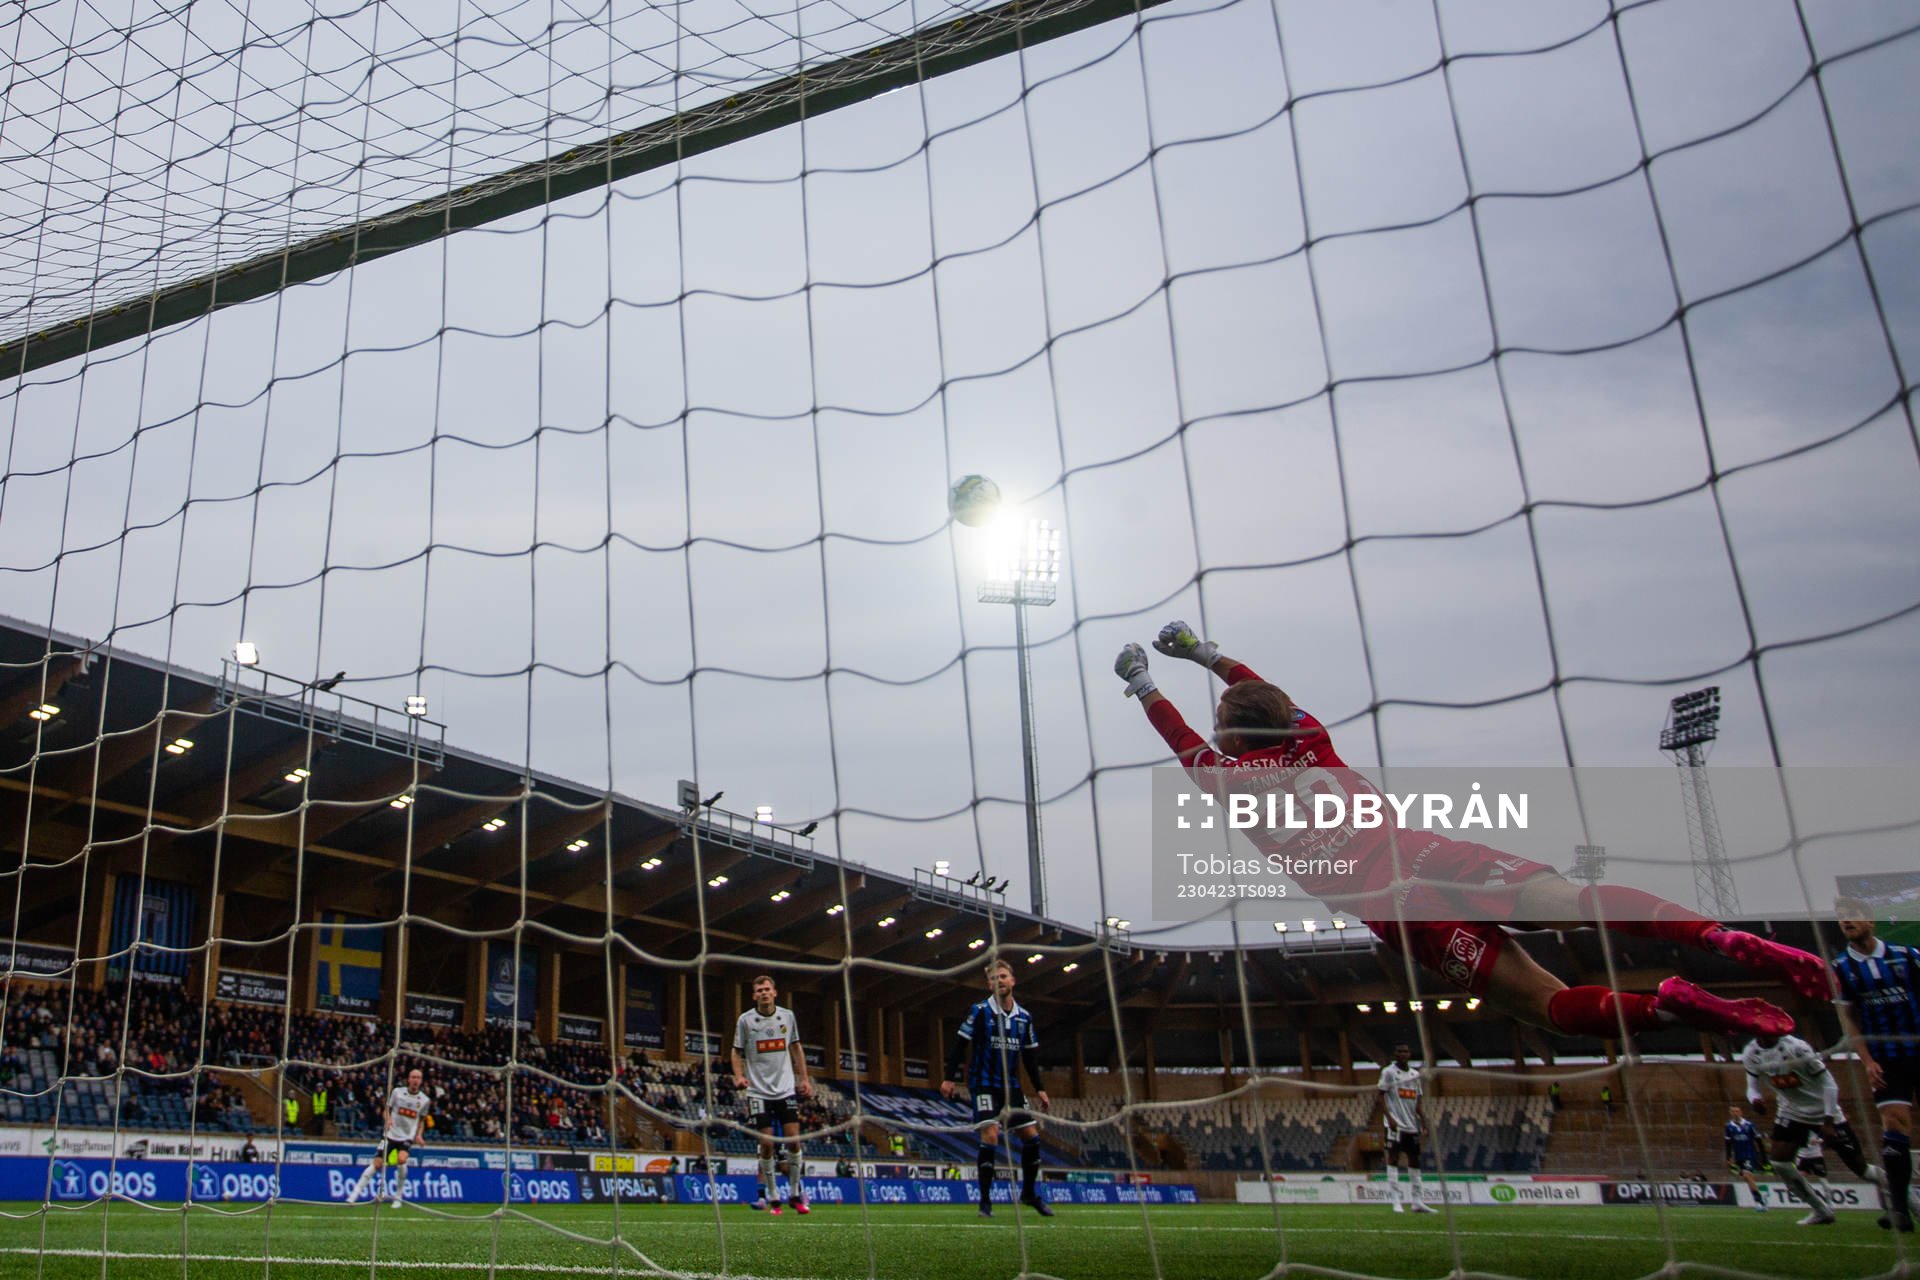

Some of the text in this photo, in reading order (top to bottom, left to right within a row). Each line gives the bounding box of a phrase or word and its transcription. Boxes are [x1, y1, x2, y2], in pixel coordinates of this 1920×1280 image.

[89, 1171, 157, 1196] OBOS
[222, 1174, 281, 1197] OBOS
[328, 1169, 463, 1198] Botäder från
[527, 1179, 571, 1199] OBOS
[600, 1177, 658, 1197] UPPSALA
[704, 1182, 739, 1200] OBOS
[818, 1180, 843, 1200] från
[880, 1185, 907, 1201] OBOS
[927, 1186, 951, 1201] OBOS
[1519, 1185, 1563, 1200] mella
[1566, 1185, 1580, 1200] el
[1773, 1188, 1859, 1204] TEOS
